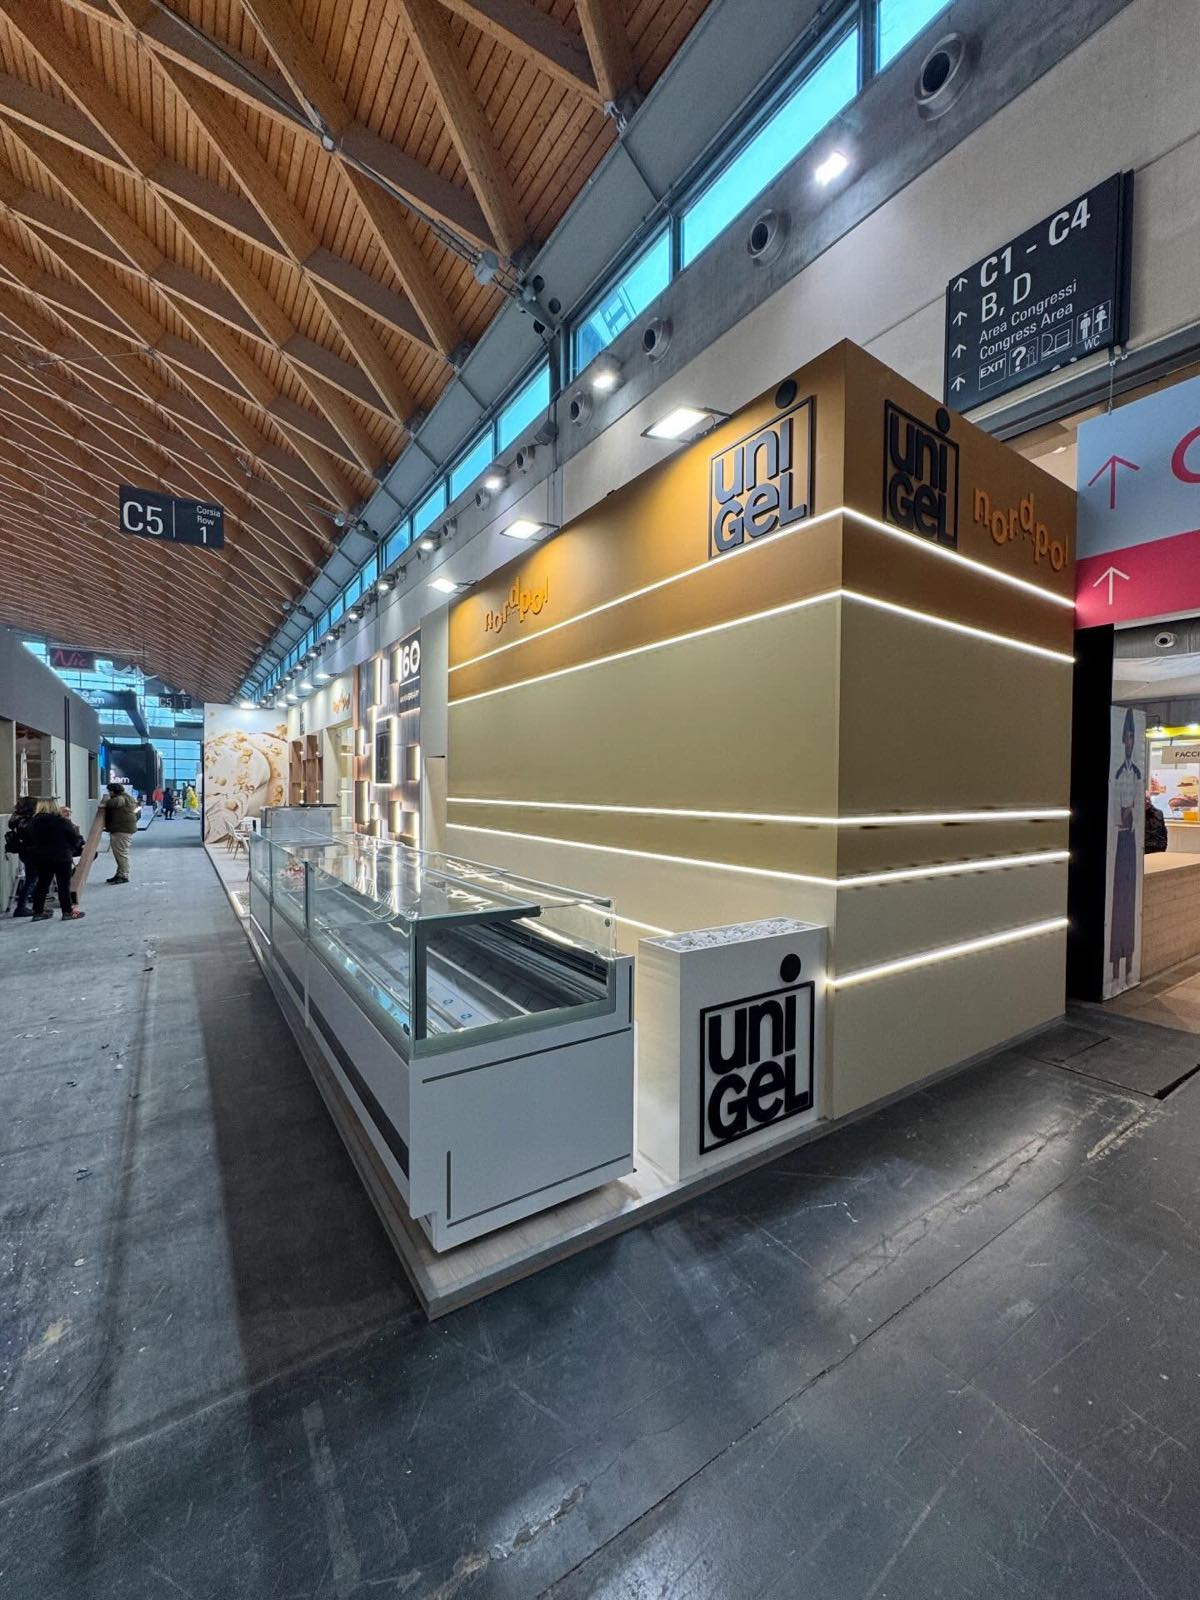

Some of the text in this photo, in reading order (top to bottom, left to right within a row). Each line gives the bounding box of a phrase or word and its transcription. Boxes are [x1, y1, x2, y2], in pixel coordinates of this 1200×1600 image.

[980, 246, 1012, 288] C1
[1048, 198, 1091, 246] C4
[979, 278, 1077, 344] Area Congressi
[981, 272, 1032, 323] B, D
[979, 303, 1073, 360] Congress Area
[1083, 335, 1101, 351] WC
[980, 357, 1006, 378] EXIT
[122, 500, 164, 535] C5
[196, 505, 221, 518] Corsia
[196, 515, 215, 526] Row
[199, 526, 207, 544] 1
[973, 487, 1069, 572] nordpol
